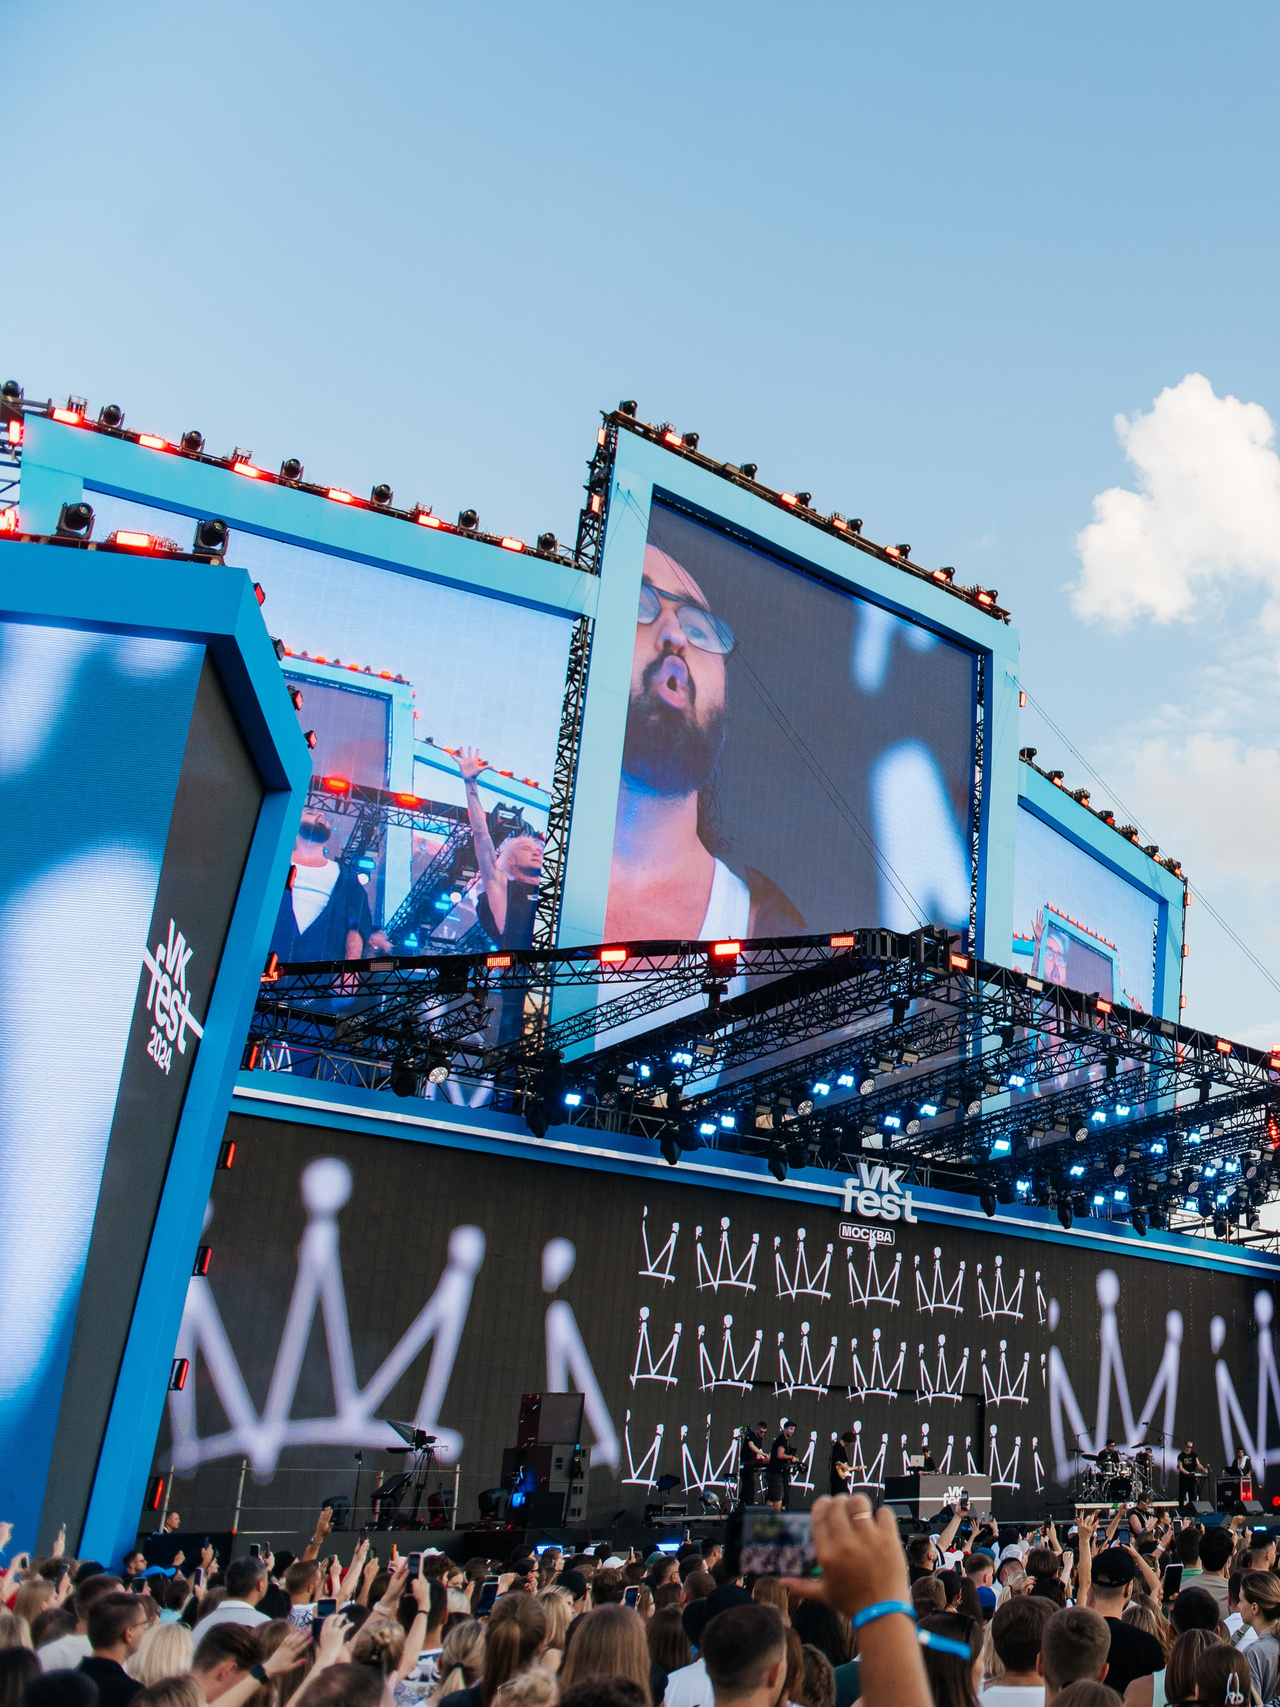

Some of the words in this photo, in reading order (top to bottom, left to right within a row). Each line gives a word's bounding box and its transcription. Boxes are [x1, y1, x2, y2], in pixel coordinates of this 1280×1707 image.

[165, 917, 194, 995] VK
[144, 943, 197, 1055] fest
[146, 1025, 173, 1076] 2024
[841, 1177, 918, 1224] fest
[856, 1162, 904, 1195] VK
[841, 1224, 893, 1243] МОСКВА
[947, 1486, 965, 1497] VK
